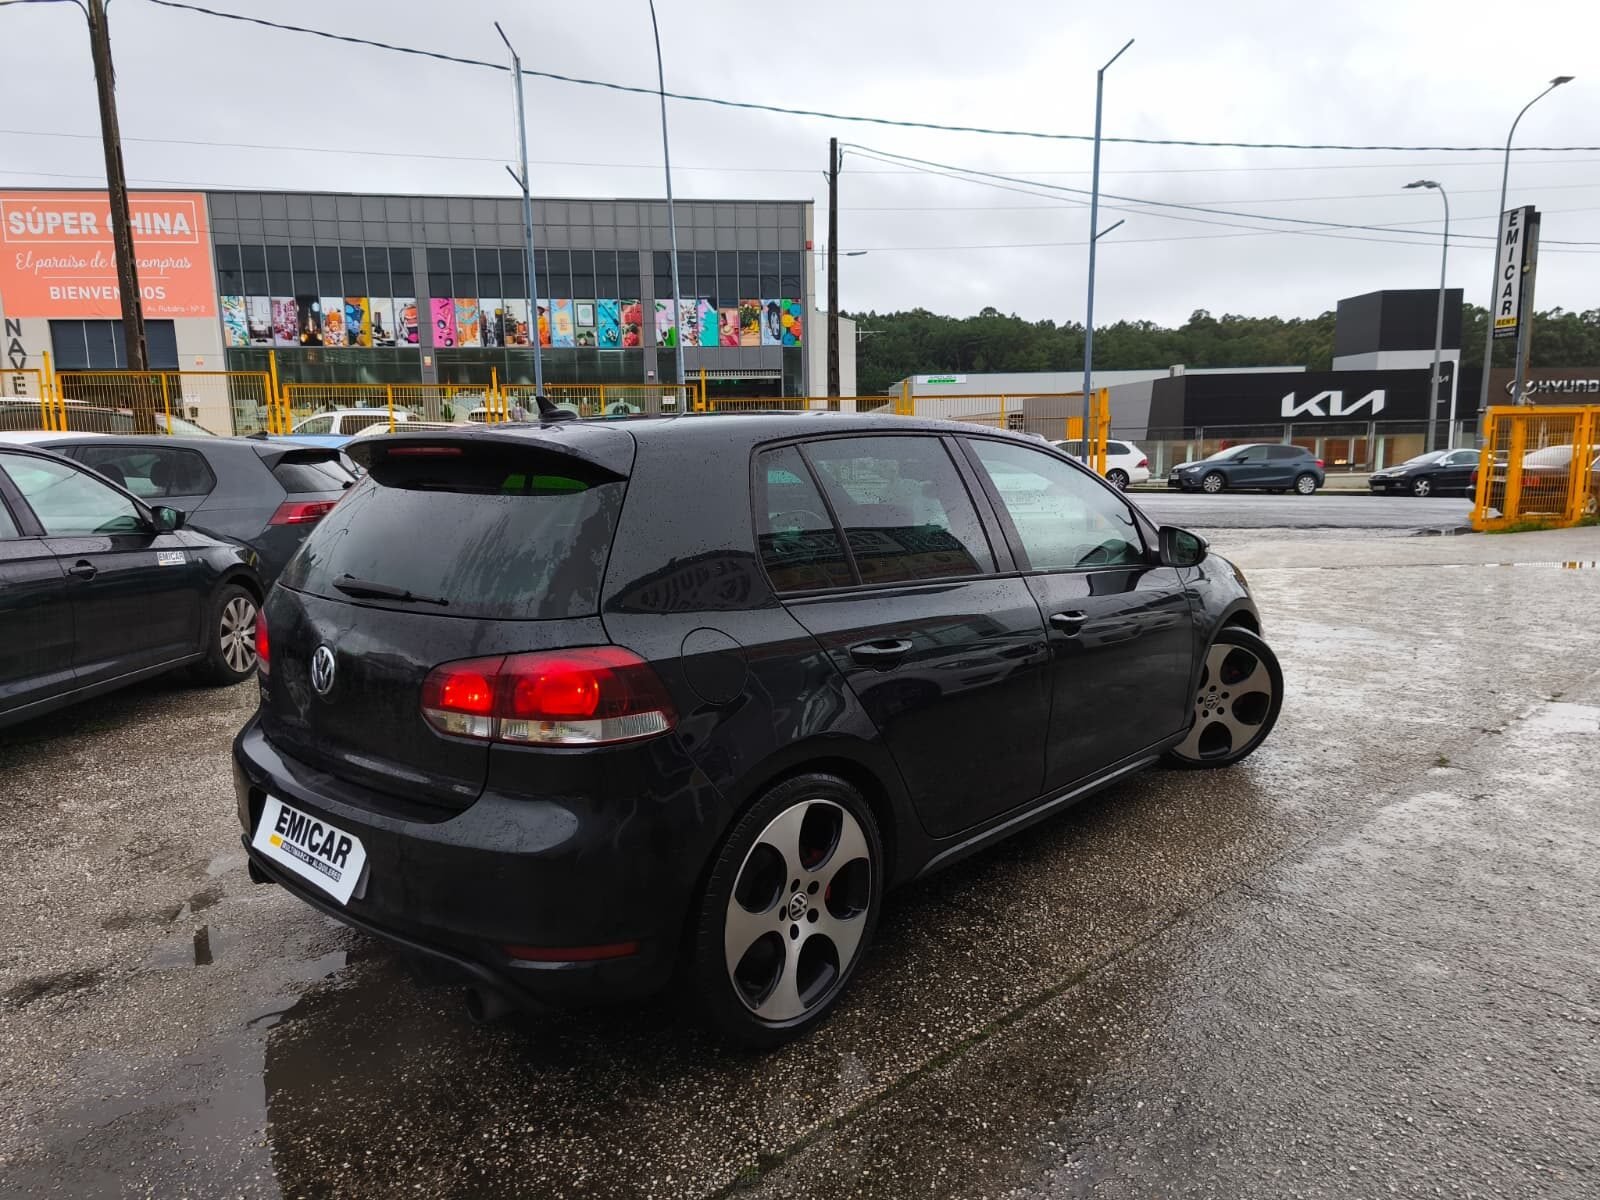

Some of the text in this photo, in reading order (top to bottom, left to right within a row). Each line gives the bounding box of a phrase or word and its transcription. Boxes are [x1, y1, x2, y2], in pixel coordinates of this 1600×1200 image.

[9, 206, 99, 235] SÚPER
[16, 250, 33, 270] El
[90, 249, 109, 269] de
[136, 255, 193, 276] compras
[1501, 211, 1520, 316] EMICAR
[50, 285, 166, 300] BIENVENOS
[1281, 389, 1386, 418] KIA
[274, 804, 353, 869] EMICAR
